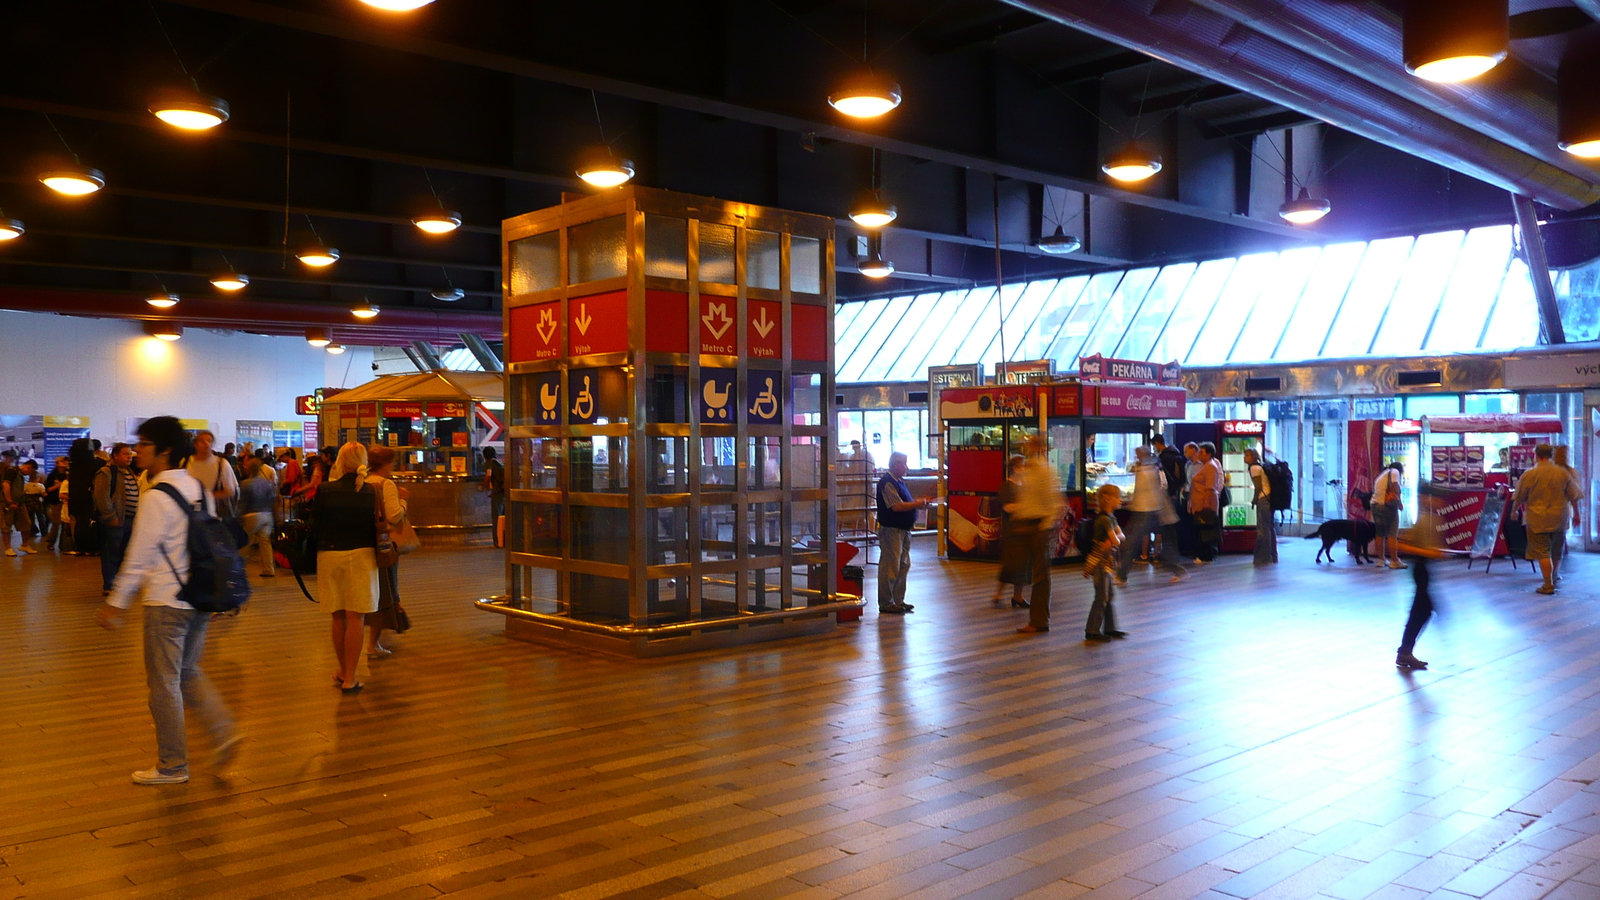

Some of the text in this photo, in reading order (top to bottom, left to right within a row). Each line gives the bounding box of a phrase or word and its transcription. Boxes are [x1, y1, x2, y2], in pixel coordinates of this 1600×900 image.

[574, 344, 591, 355] Výtah
[702, 343, 733, 353] Metro C
[753, 346, 774, 357] Výtah
[1112, 363, 1153, 379] PEKÁRNA
[1109, 397, 1121, 406] COLD
[1126, 394, 1153, 410] Coca-Cola
